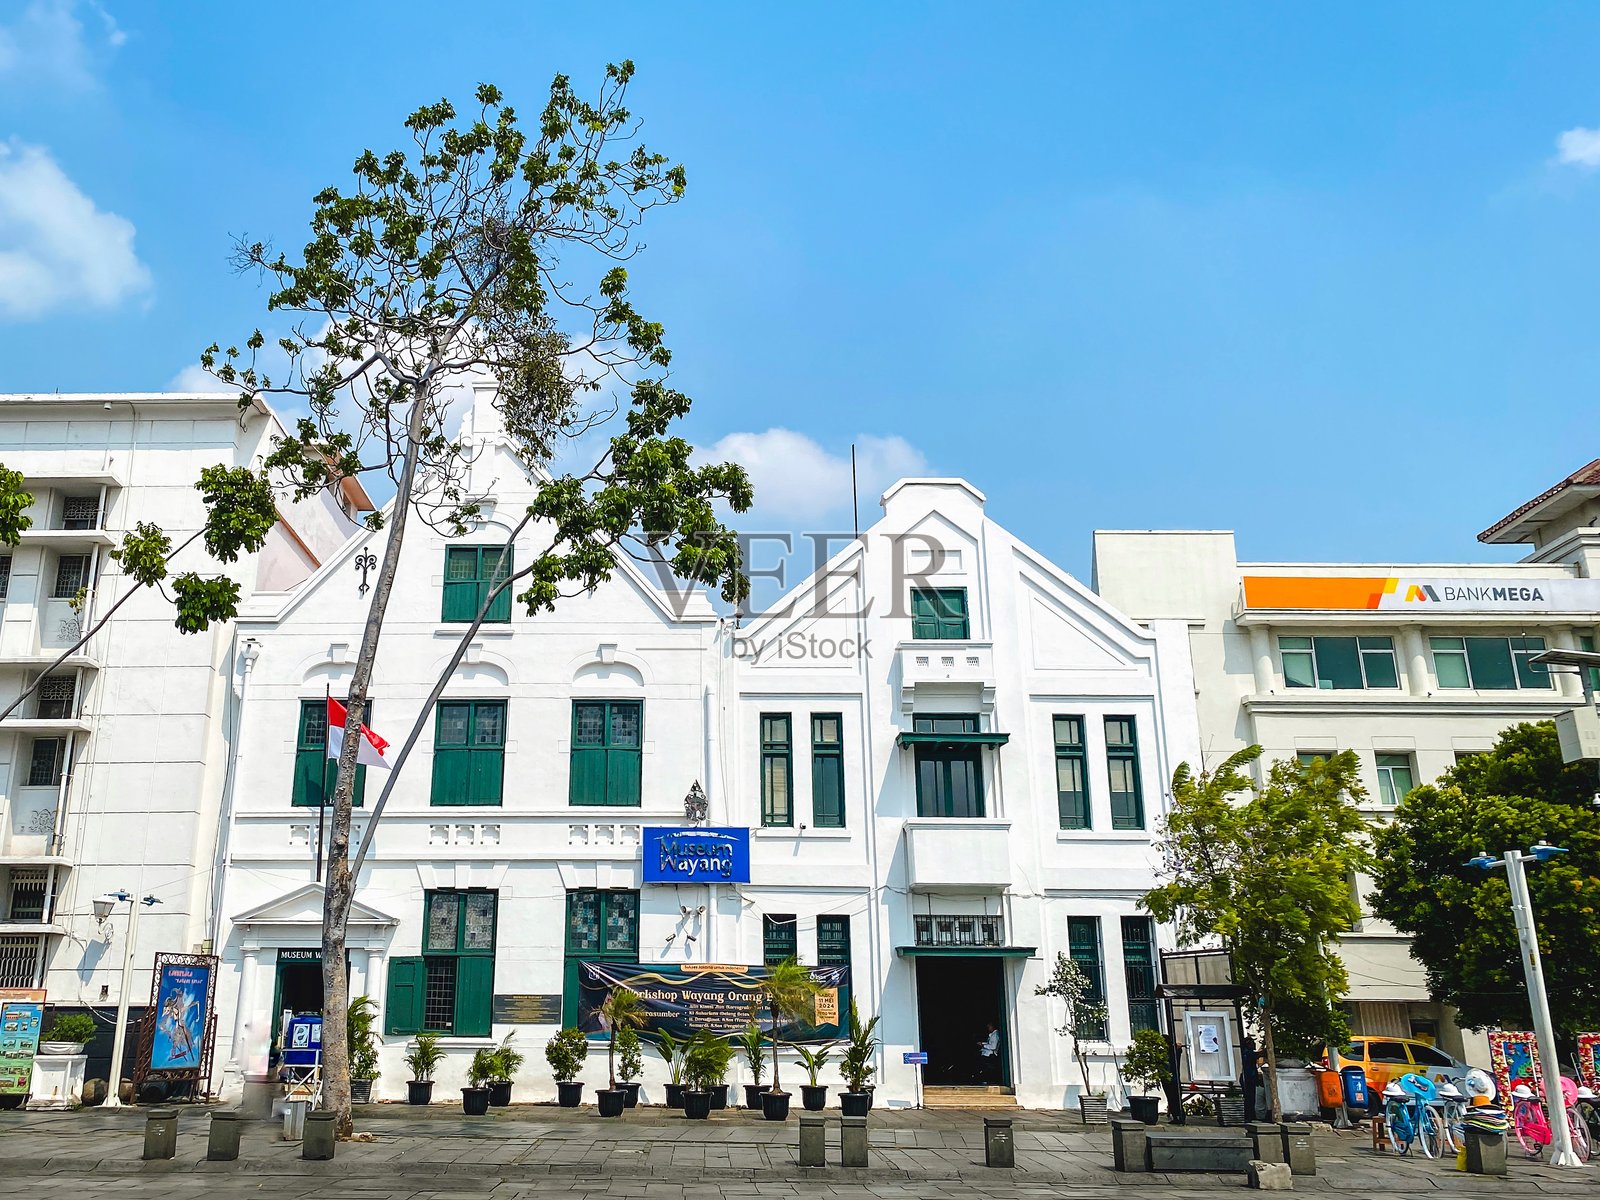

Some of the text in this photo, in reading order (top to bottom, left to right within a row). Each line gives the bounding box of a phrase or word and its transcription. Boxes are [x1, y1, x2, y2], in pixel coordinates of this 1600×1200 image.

[660, 839, 733, 857] Museum
[660, 855, 733, 877] Wayang
[281, 951, 313, 959] MUSEUM
[681, 990, 724, 1003] Wayang
[728, 991, 763, 1005] Orang
